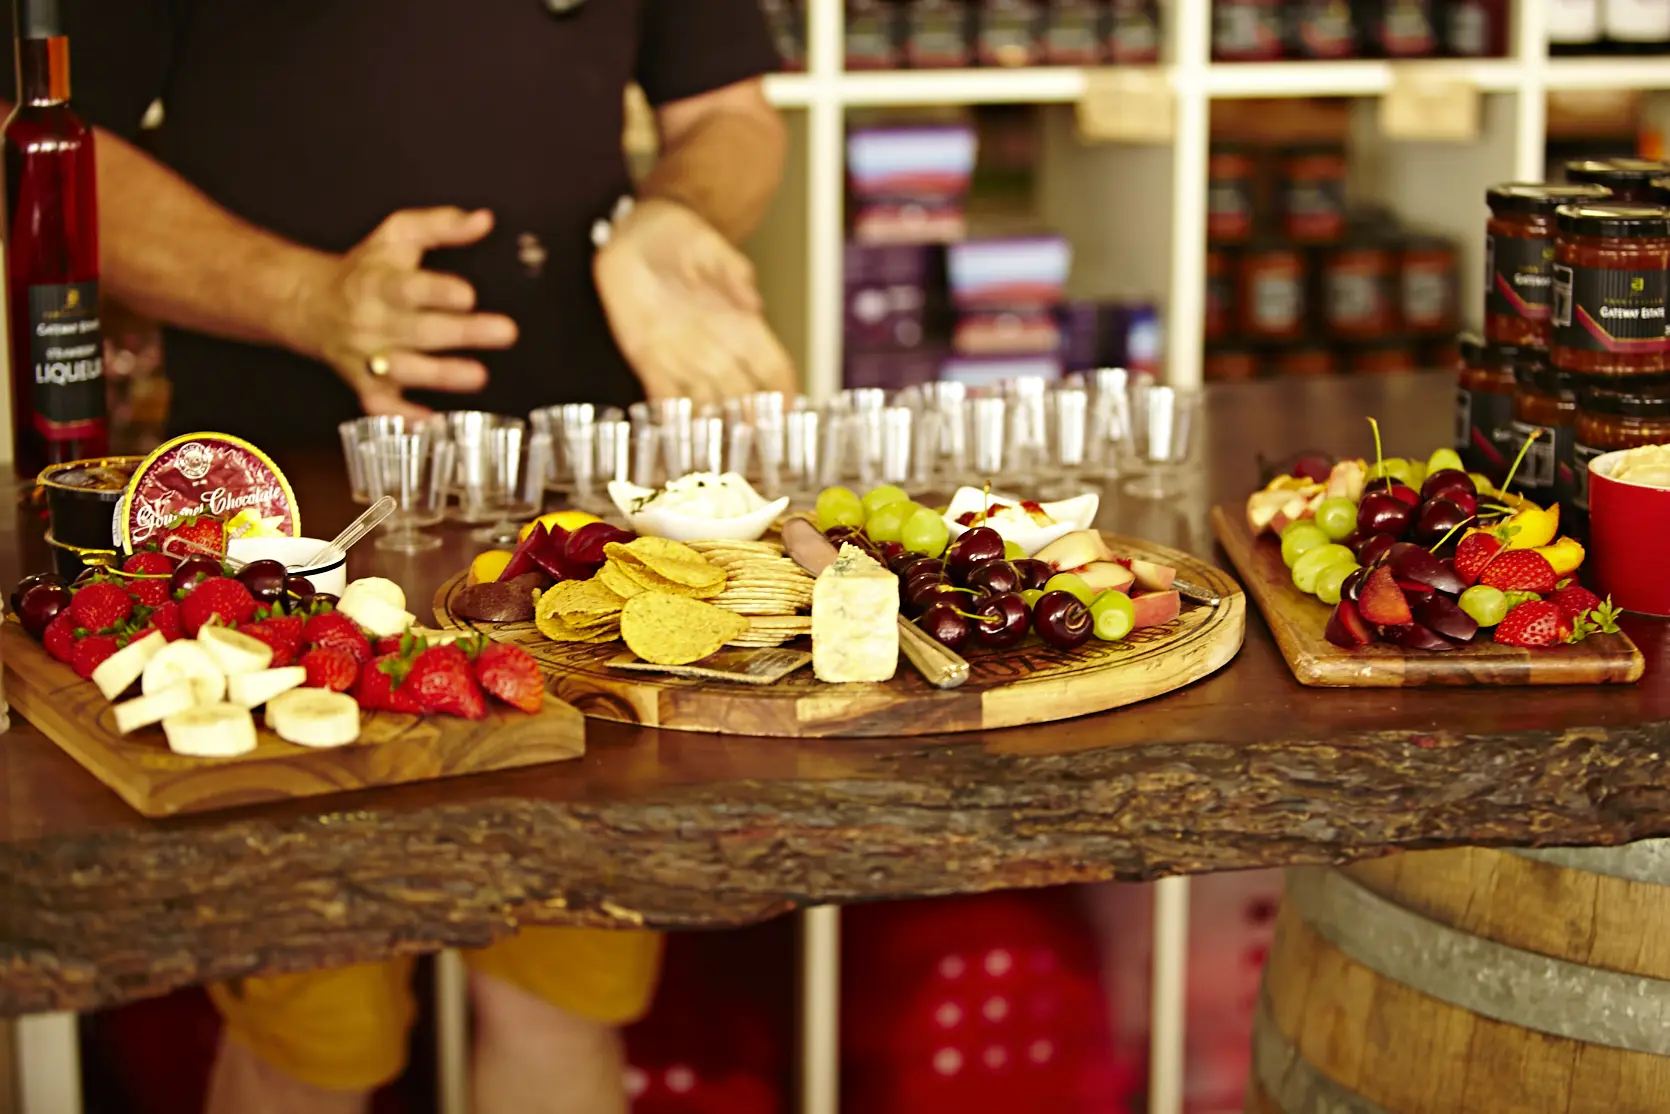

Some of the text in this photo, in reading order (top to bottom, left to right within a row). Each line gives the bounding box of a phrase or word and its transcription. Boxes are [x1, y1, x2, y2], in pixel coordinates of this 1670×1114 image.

[1600, 306, 1665, 319] GATEWAY ESTATE
[35, 358, 103, 385] LIQUEU
[200, 487, 282, 516] Chocolate
